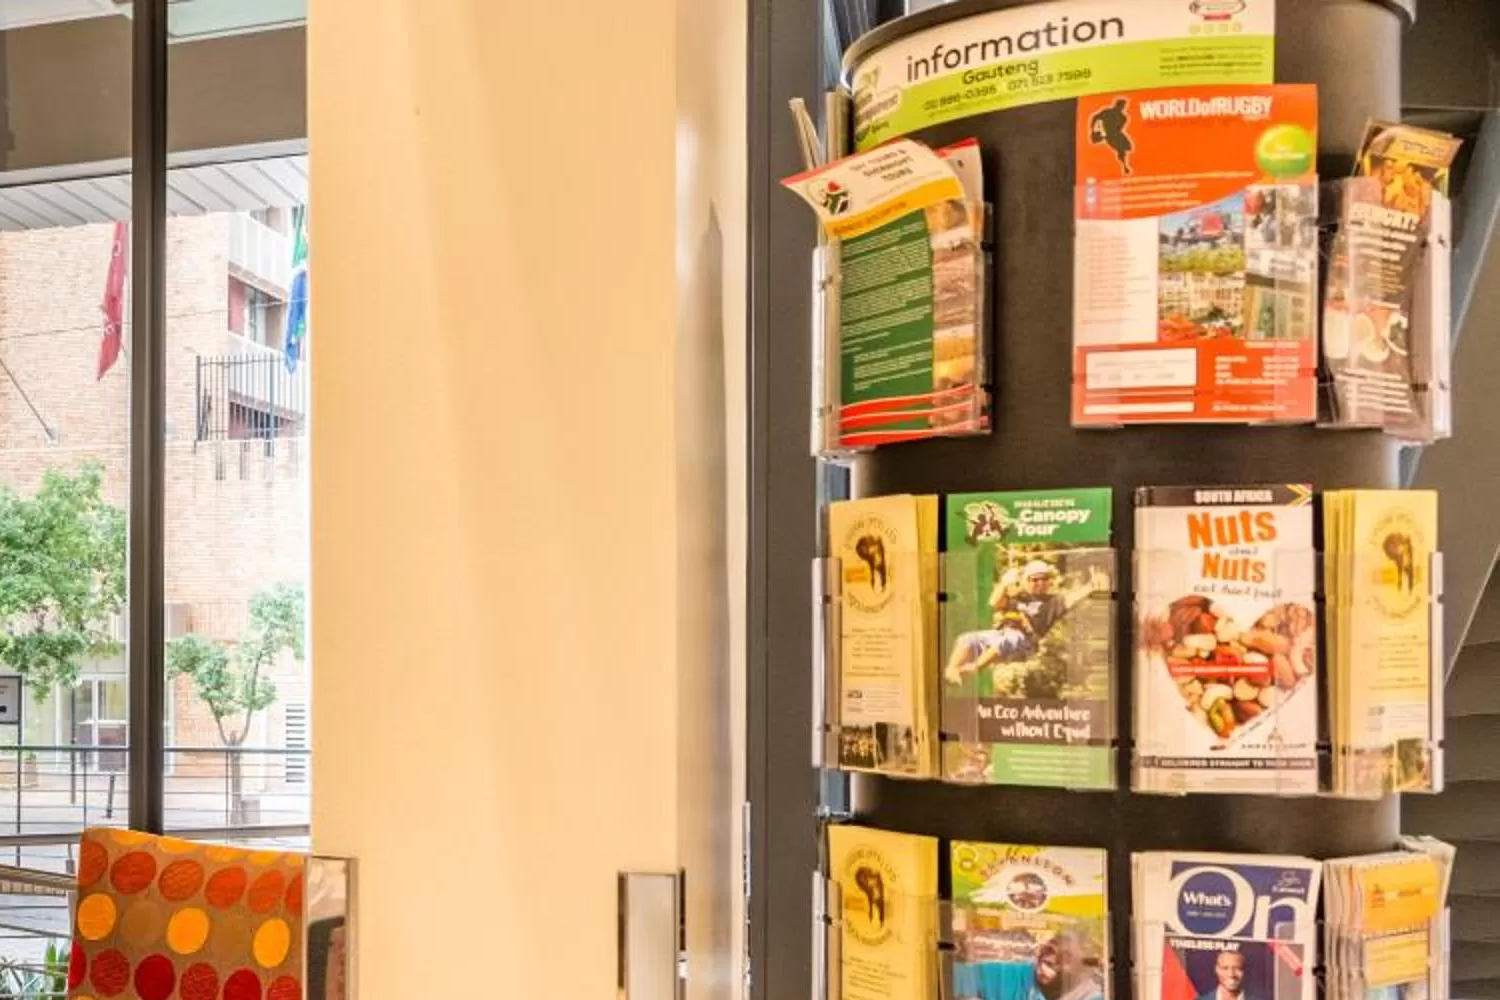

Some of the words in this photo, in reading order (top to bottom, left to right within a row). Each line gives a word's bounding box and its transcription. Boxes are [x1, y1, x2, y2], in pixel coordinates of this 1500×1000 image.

[906, 16, 1125, 83] information
[961, 59, 1039, 85] Gauteng
[1018, 508, 1092, 524] Canopy
[1016, 523, 1060, 537] Tour
[1187, 510, 1278, 549] Nuts
[1201, 551, 1267, 584] Nuts
[1183, 891, 1233, 908] What's
